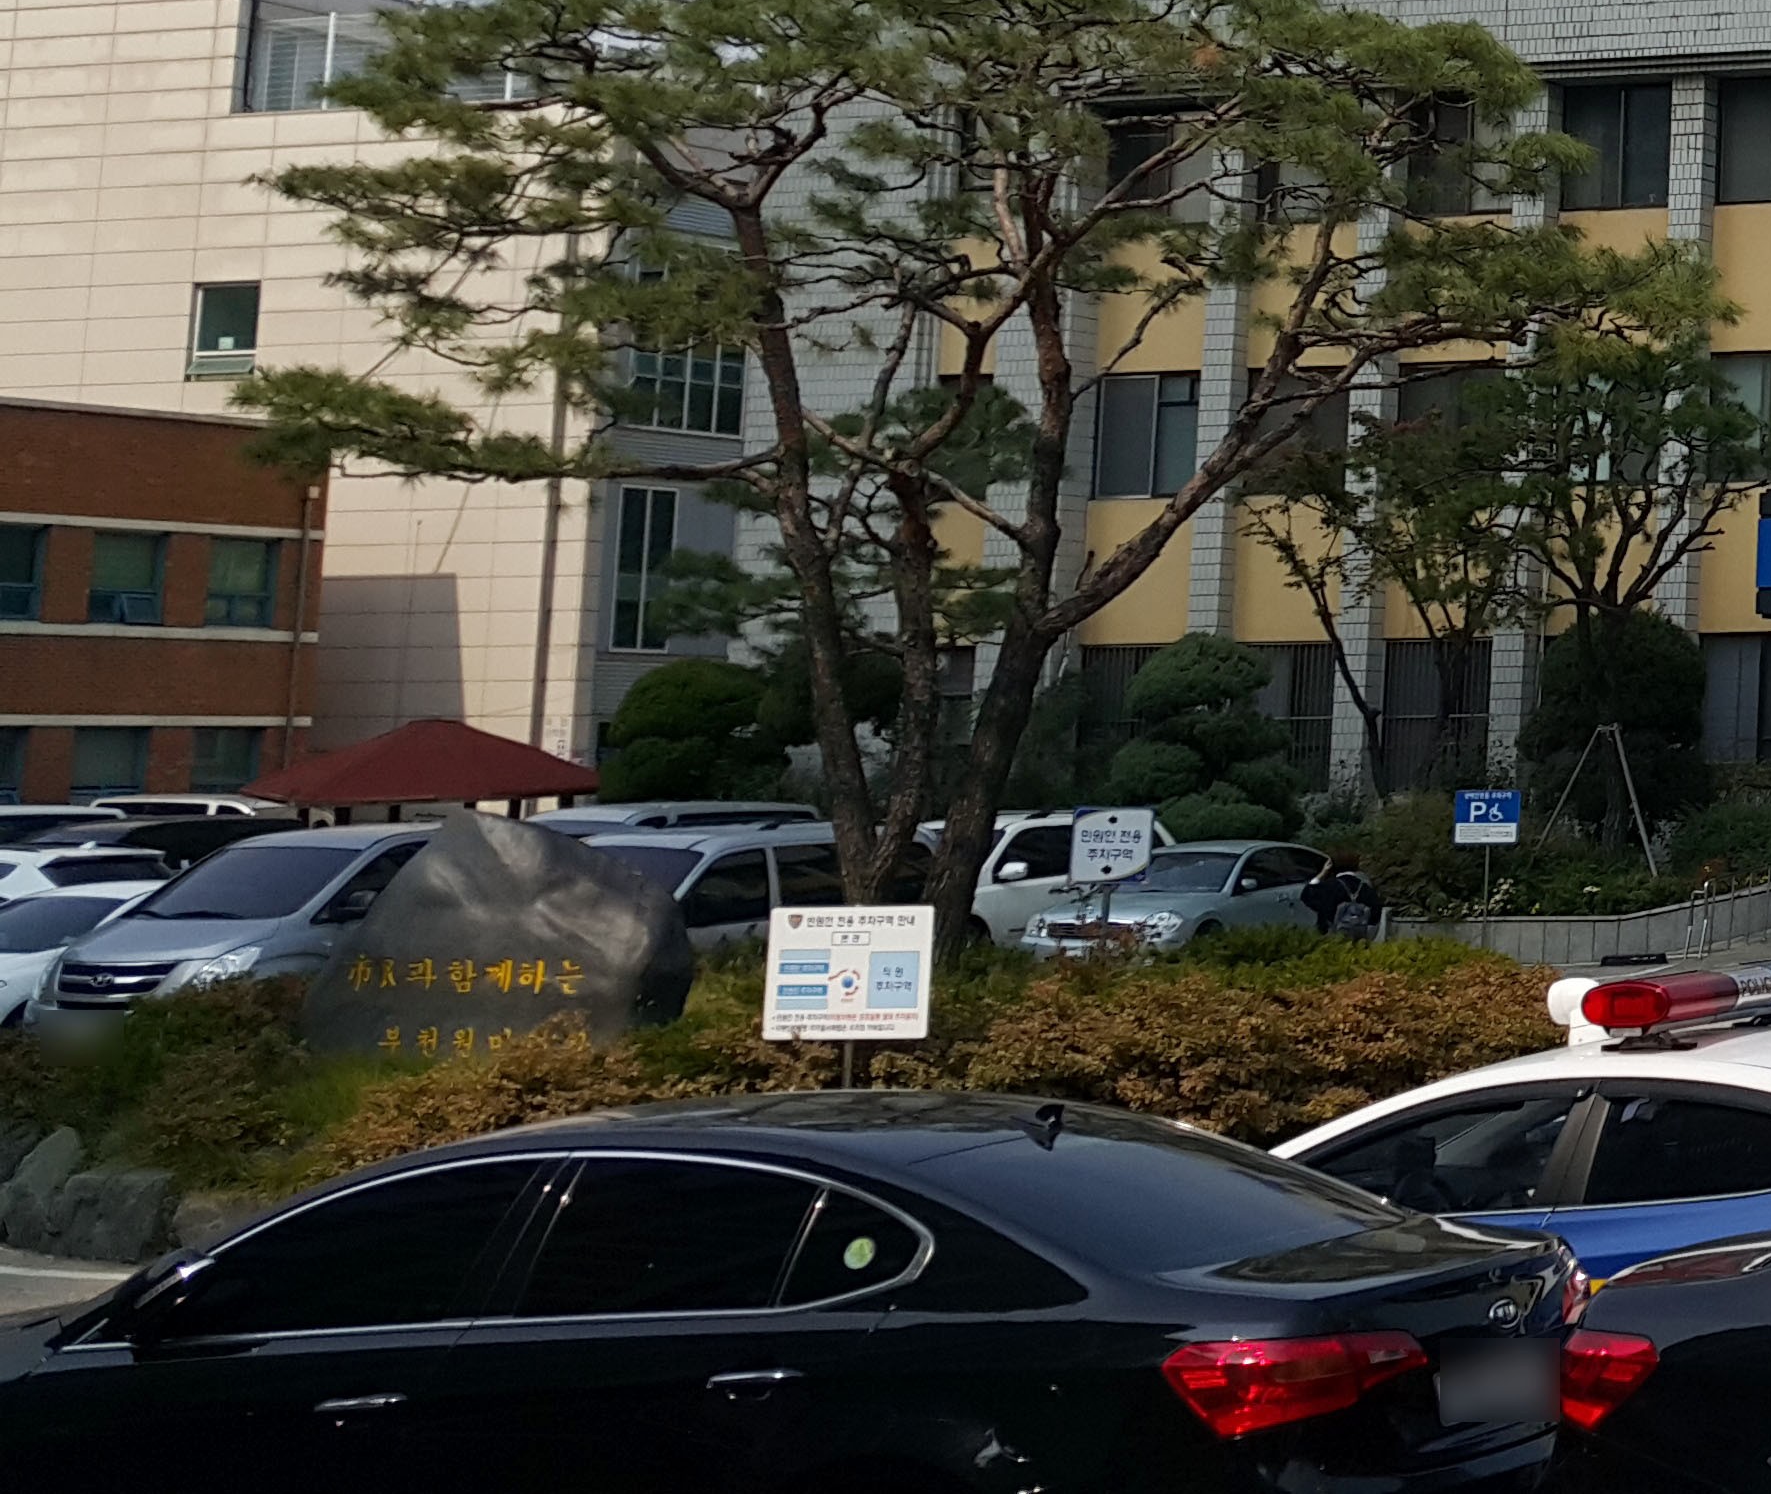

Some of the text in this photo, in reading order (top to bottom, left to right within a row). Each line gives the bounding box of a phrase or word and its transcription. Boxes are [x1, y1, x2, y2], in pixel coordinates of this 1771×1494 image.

[1470, 802, 1487, 822] P
[1119, 830, 1142, 843] 전용
[1087, 848, 1134, 861] 주차구역
